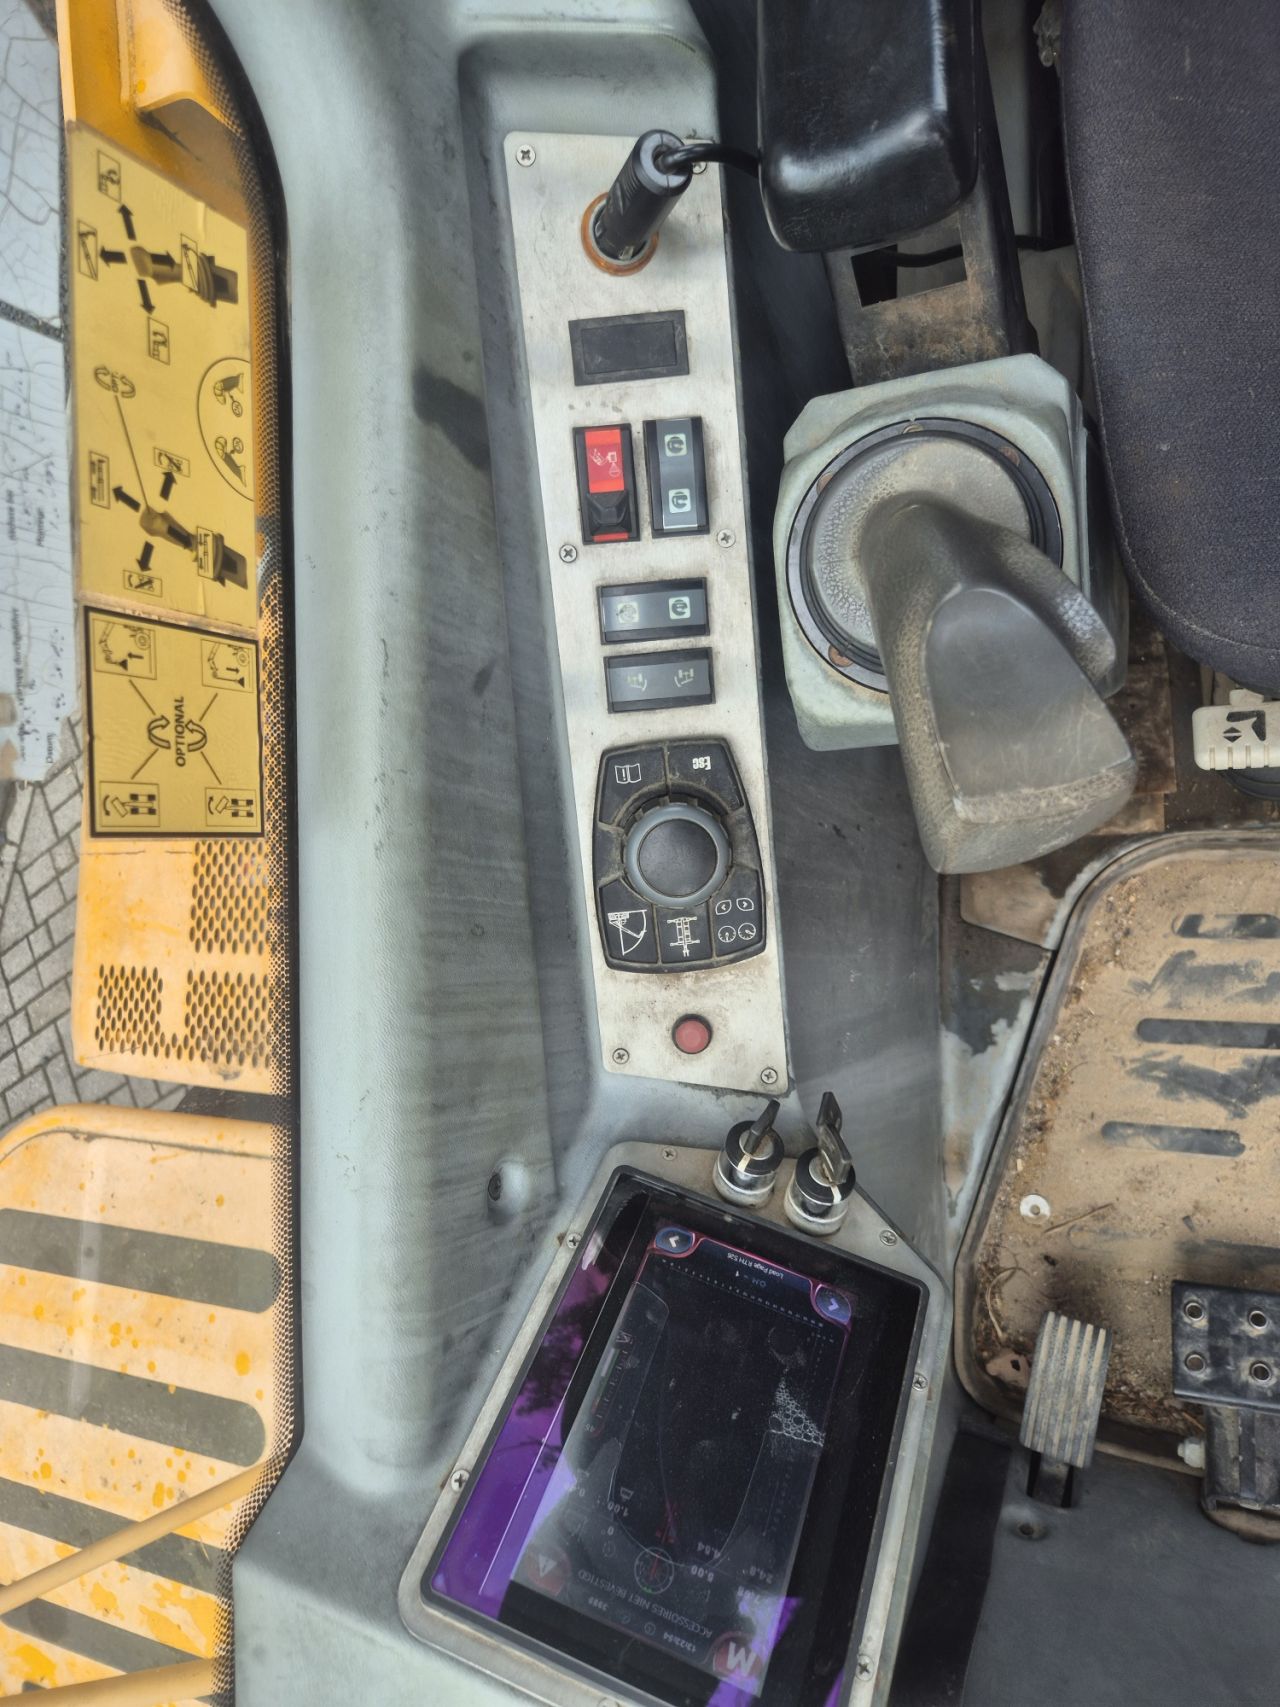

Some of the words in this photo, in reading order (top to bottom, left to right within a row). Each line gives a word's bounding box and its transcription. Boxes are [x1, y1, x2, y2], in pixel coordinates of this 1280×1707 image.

[110, 372, 120, 393] OPT.
[174, 696, 186, 768] OPTIONAL
[692, 755, 712, 771] Esc
[754, 1263, 768, 1275] Page
[769, 1268, 785, 1280] Load
[628, 1593, 651, 1611] NIET
[652, 1603, 713, 1639] ACCESSOIRES
[726, 1641, 758, 1678] M
